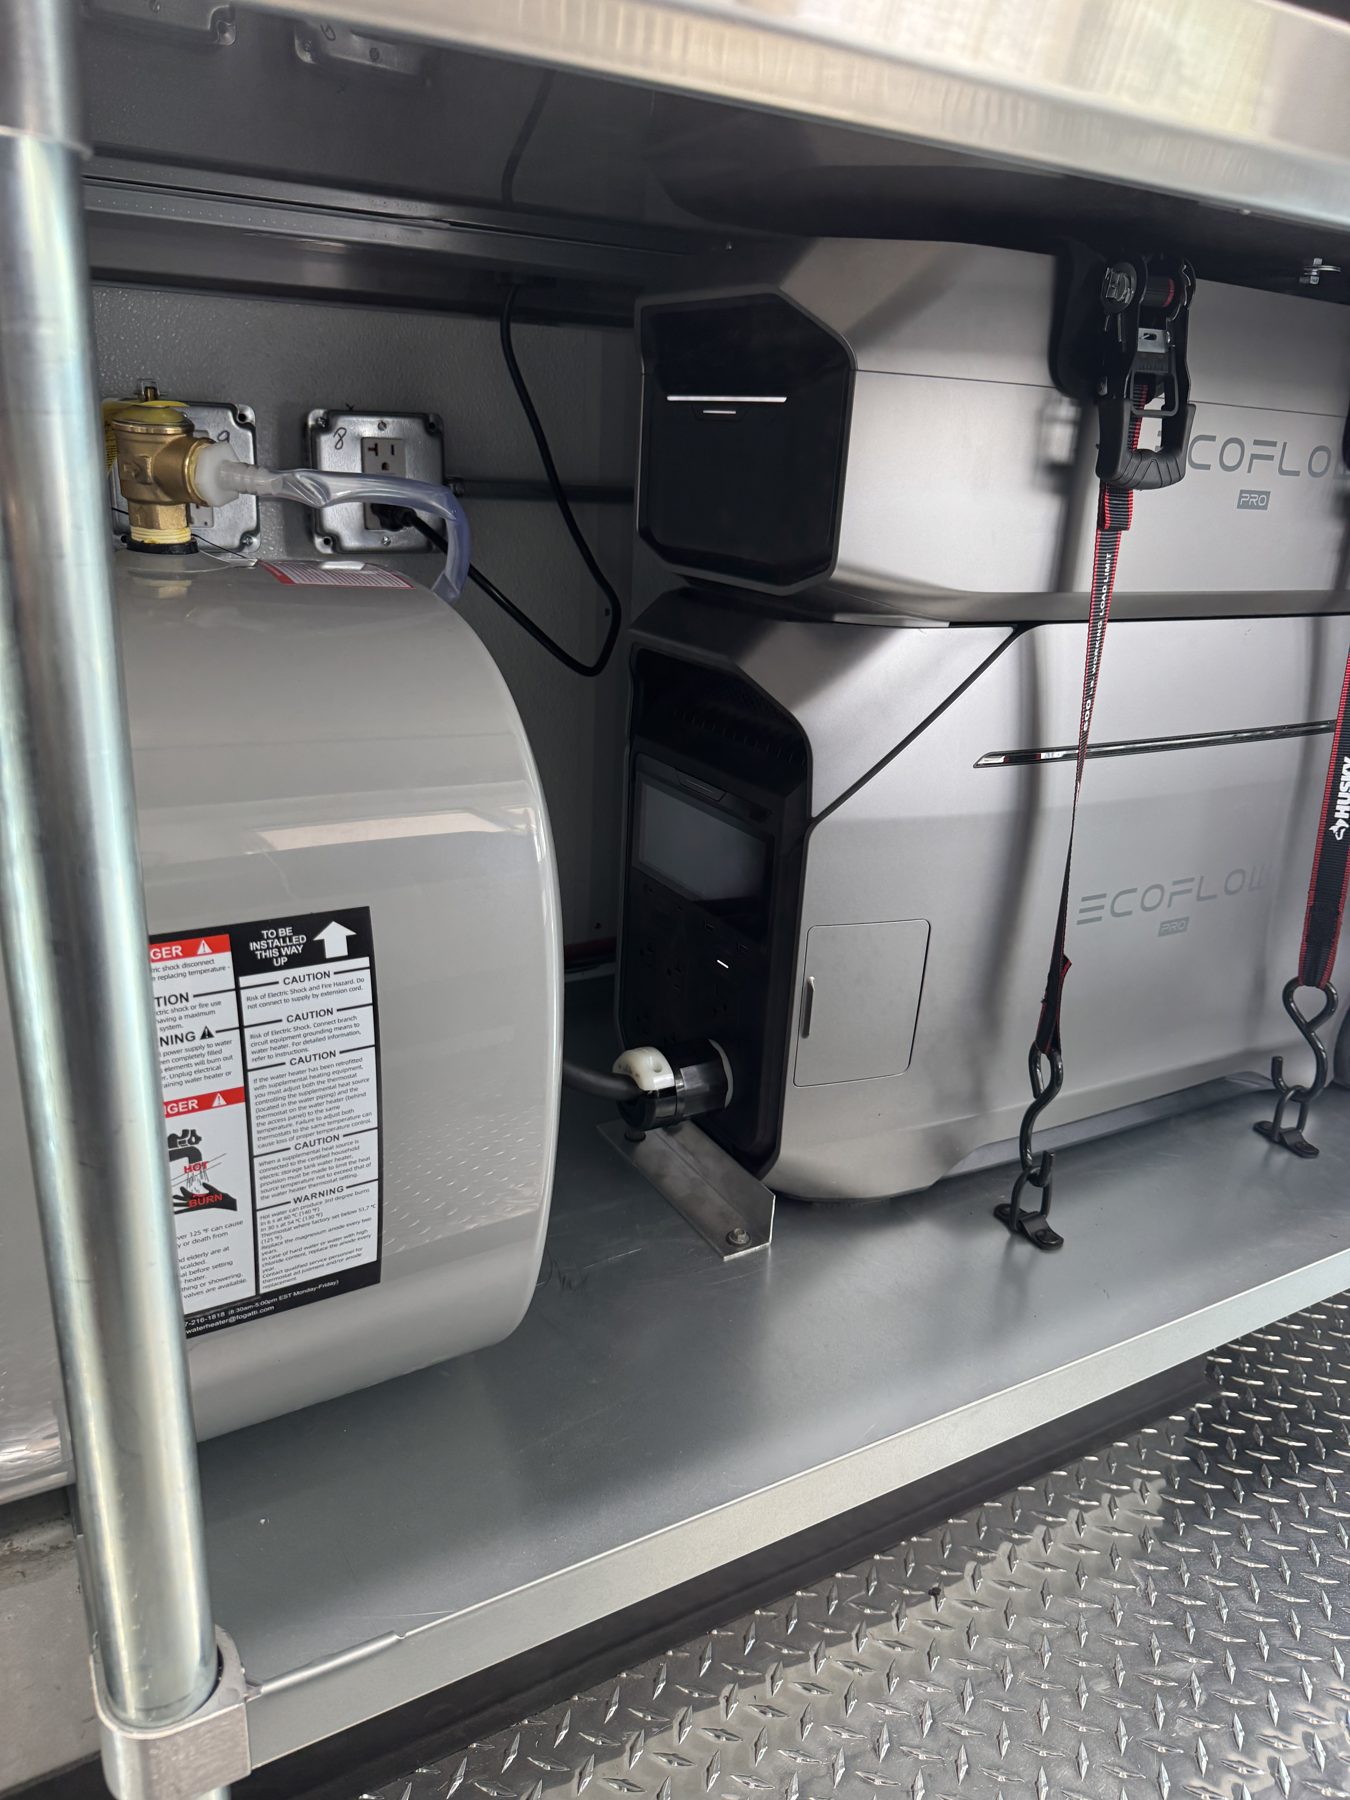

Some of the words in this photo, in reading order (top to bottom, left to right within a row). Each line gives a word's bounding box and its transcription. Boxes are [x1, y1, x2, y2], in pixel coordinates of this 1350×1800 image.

[1186, 434, 1345, 479] COFLO
[1239, 492, 1268, 507] PRO
[1092, 621, 1103, 675] WORKING
[1099, 585, 1107, 616] LOAD
[1103, 553, 1112, 583] LIMIT
[261, 929, 277, 939] TO
[278, 926, 294, 937] BE
[249, 934, 307, 951] INSTALLED
[150, 945, 183, 960] GER
[255, 948, 280, 960] THIS
[280, 944, 304, 956] WAY
[273, 956, 288, 967] UP
[158, 971, 187, 982] replacing
[188, 965, 226, 978] temperature
[283, 970, 331, 985] CAUTION
[268, 990, 288, 998] Electric
[334, 979, 355, 987] Hazard.
[155, 992, 189, 1008] TION
[259, 999, 282, 1007] connect
[292, 994, 310, 1003] supply
[321, 988, 347, 997] extension
[184, 1009, 216, 1020] maximum
[287, 1007, 333, 1023] CAUTION
[271, 1027, 291, 1036] Electric
[293, 1023, 311, 1032] Shock.
[313, 1019, 336, 1028] Connect
[338, 1015, 357, 1023] branch
[160, 1031, 196, 1047] NING
[251, 1039, 268, 1047] circuit
[270, 1033, 301, 1045] equipment
[303, 1027, 332, 1039] grounding
[163, 1050, 183, 1058] power
[185, 1044, 205, 1054] supply
[172, 1052, 206, 1064] completely
[290, 1050, 336, 1066] CAUTION
[164, 1062, 192, 1072] elements
[169, 1071, 192, 1081] Unplug
[194, 1065, 221, 1075] electrical
[185, 1076, 202, 1084] water
[204, 1072, 224, 1080] heater
[167, 1099, 198, 1115] GER
[295, 1134, 340, 1151] CAUTION
[184, 1161, 209, 1174] HOT
[188, 1193, 223, 1208] BURN
[293, 1185, 344, 1204] WARNING
[278, 1292, 292, 1301] EST
[292, 1280, 340, 1297] Monday-Friday)
